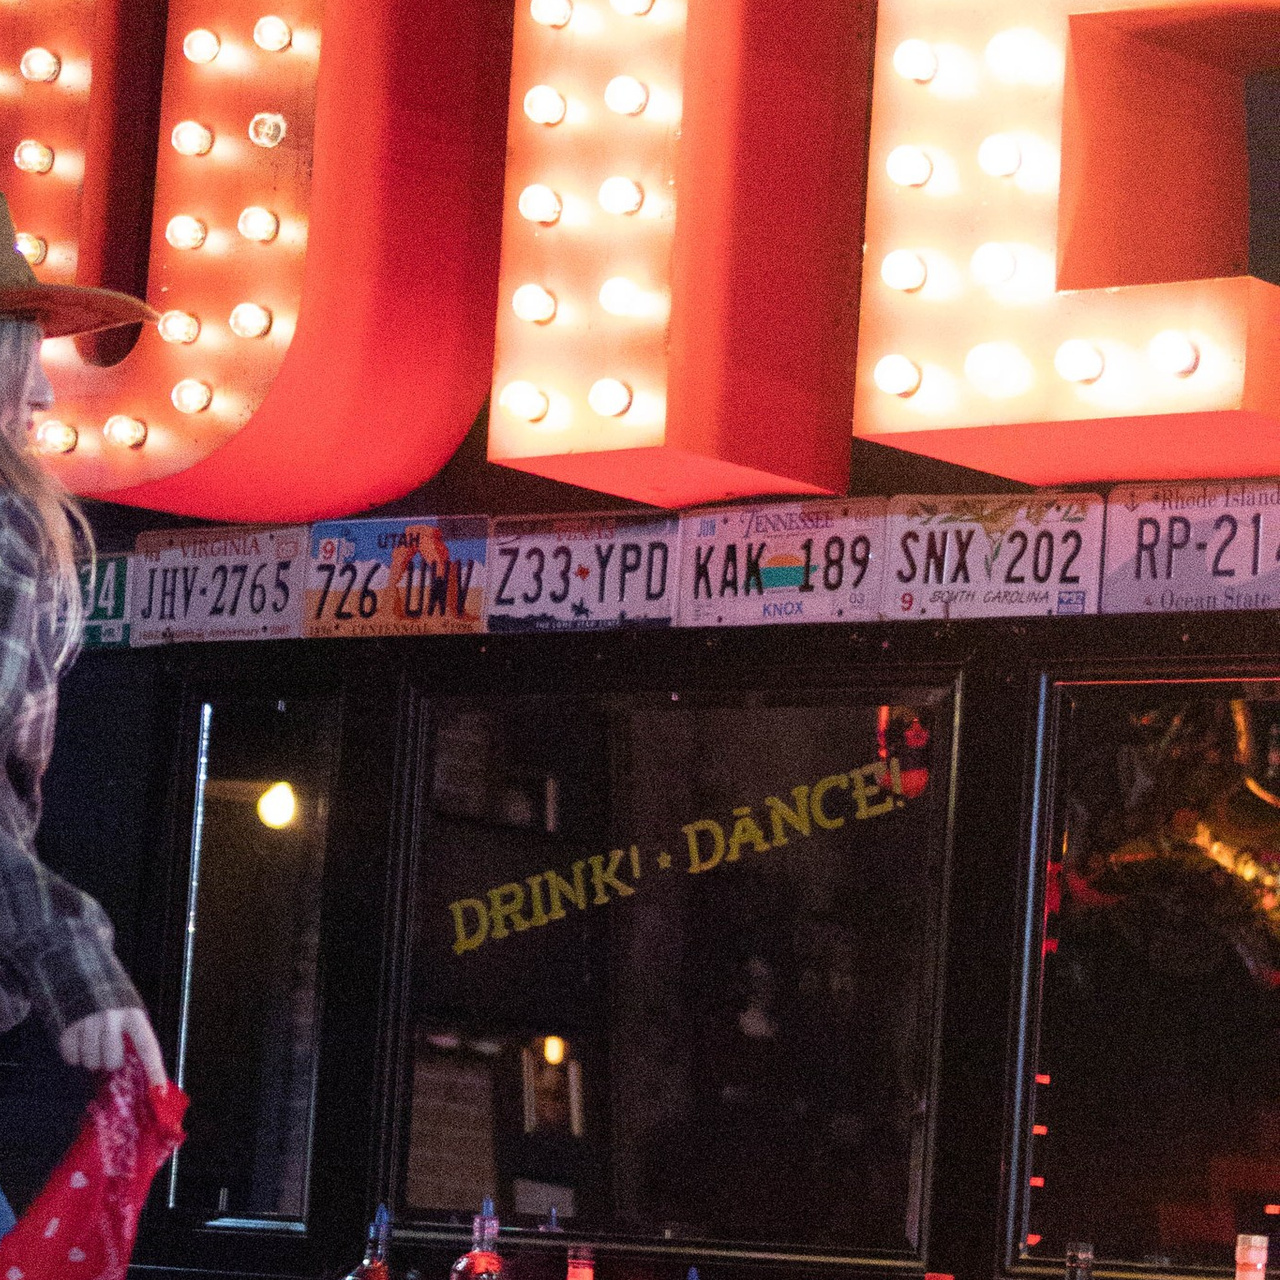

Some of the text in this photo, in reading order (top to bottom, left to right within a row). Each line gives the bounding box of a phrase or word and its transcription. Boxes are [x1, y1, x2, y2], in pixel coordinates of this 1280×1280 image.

[376, 532, 421, 549] UTAH
[741, 508, 835, 538] TENNESSEE
[180, 538, 260, 558] VIRGINIA
[693, 534, 871, 599] KAK 189
[896, 529, 1082, 583] SNX 202
[1134, 512, 1280, 580] RP-21
[314, 562, 381, 619] 726
[594, 541, 668, 602] YPD
[761, 600, 804, 617] KNOX
[928, 590, 977, 604] SOUTH
[982, 589, 1051, 605] CAROLINA
[1160, 585, 1272, 611] Ocean State
[449, 756, 905, 956] DRINK! DANCE!
